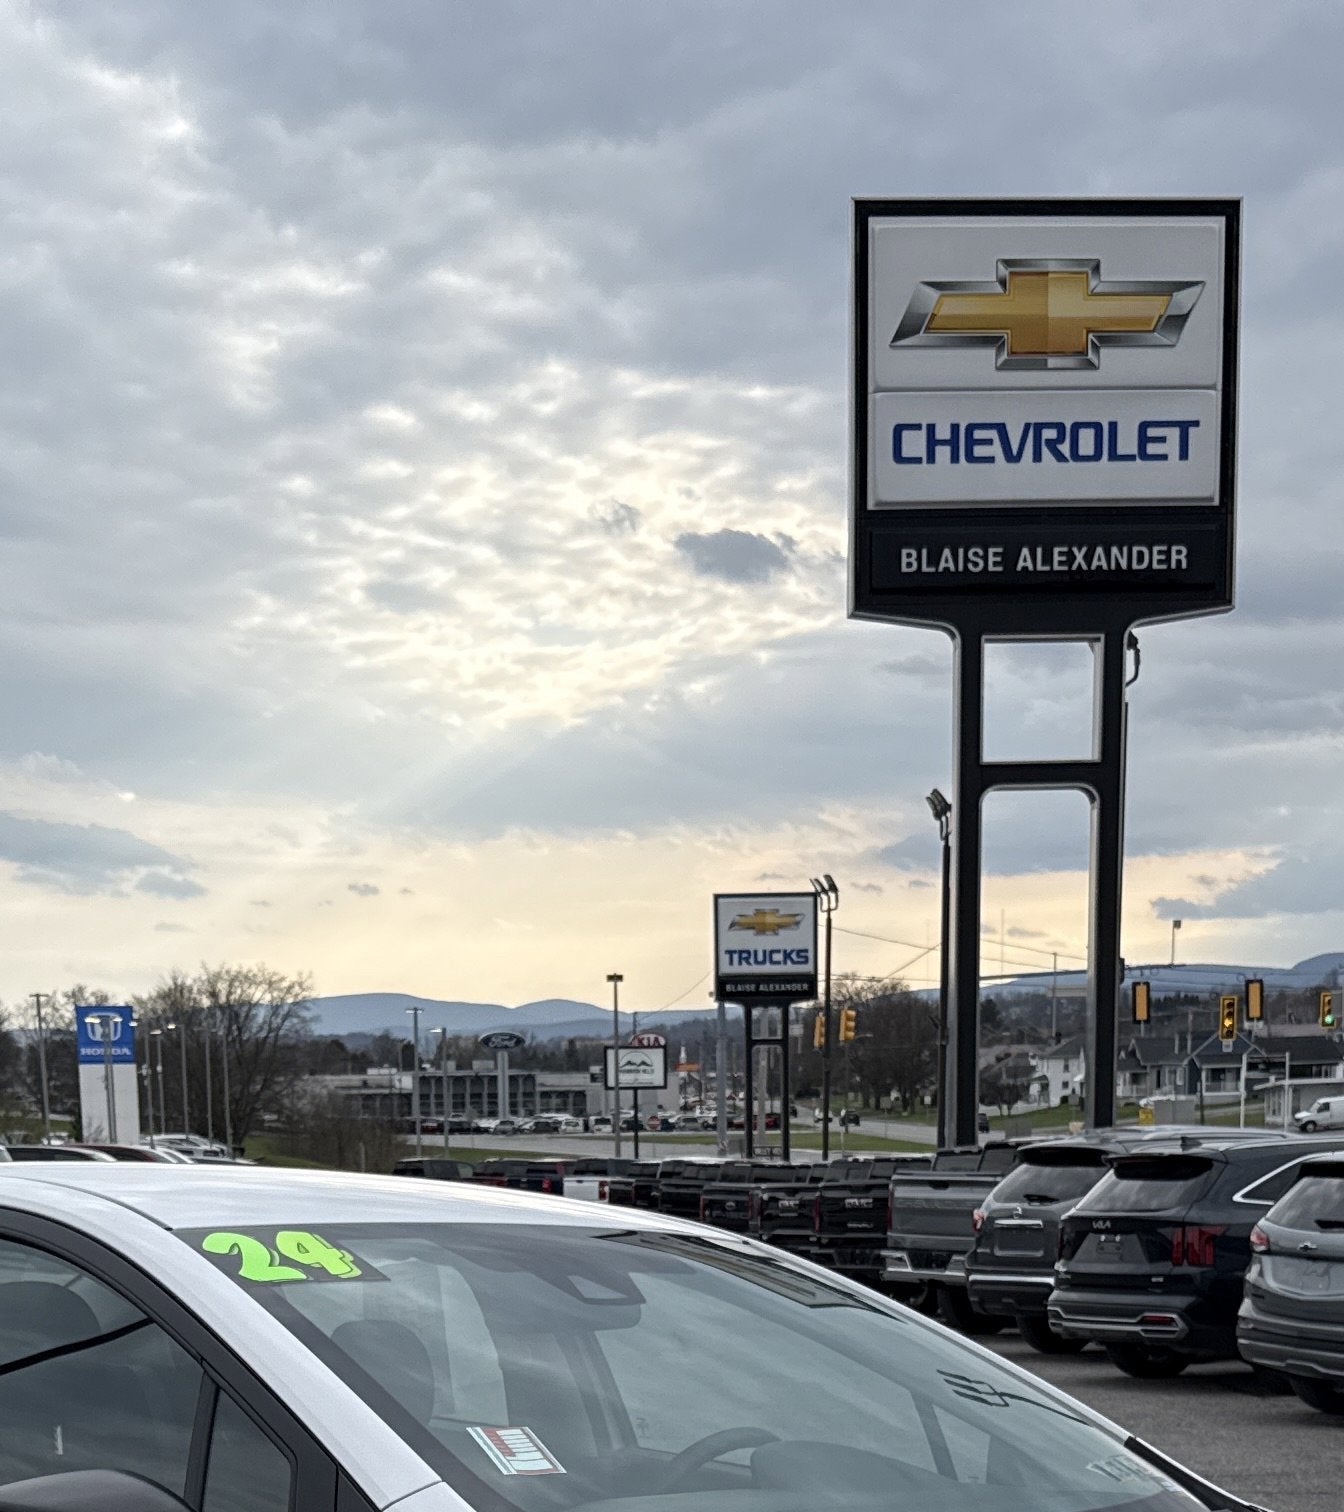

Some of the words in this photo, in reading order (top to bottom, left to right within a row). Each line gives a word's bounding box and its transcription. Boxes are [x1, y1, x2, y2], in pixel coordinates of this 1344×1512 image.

[892, 420, 1200, 464] CHEVROLET
[900, 546, 1004, 573] BLAISE
[1016, 545, 1188, 571] ALEXANDER
[724, 948, 809, 966] TRUCKS
[725, 983, 756, 992] BLAISE
[758, 983, 809, 991] ALEXANDER
[488, 1034, 519, 1048] Ford
[80, 1047, 132, 1056] HODA
[202, 1230, 362, 1282] 24
